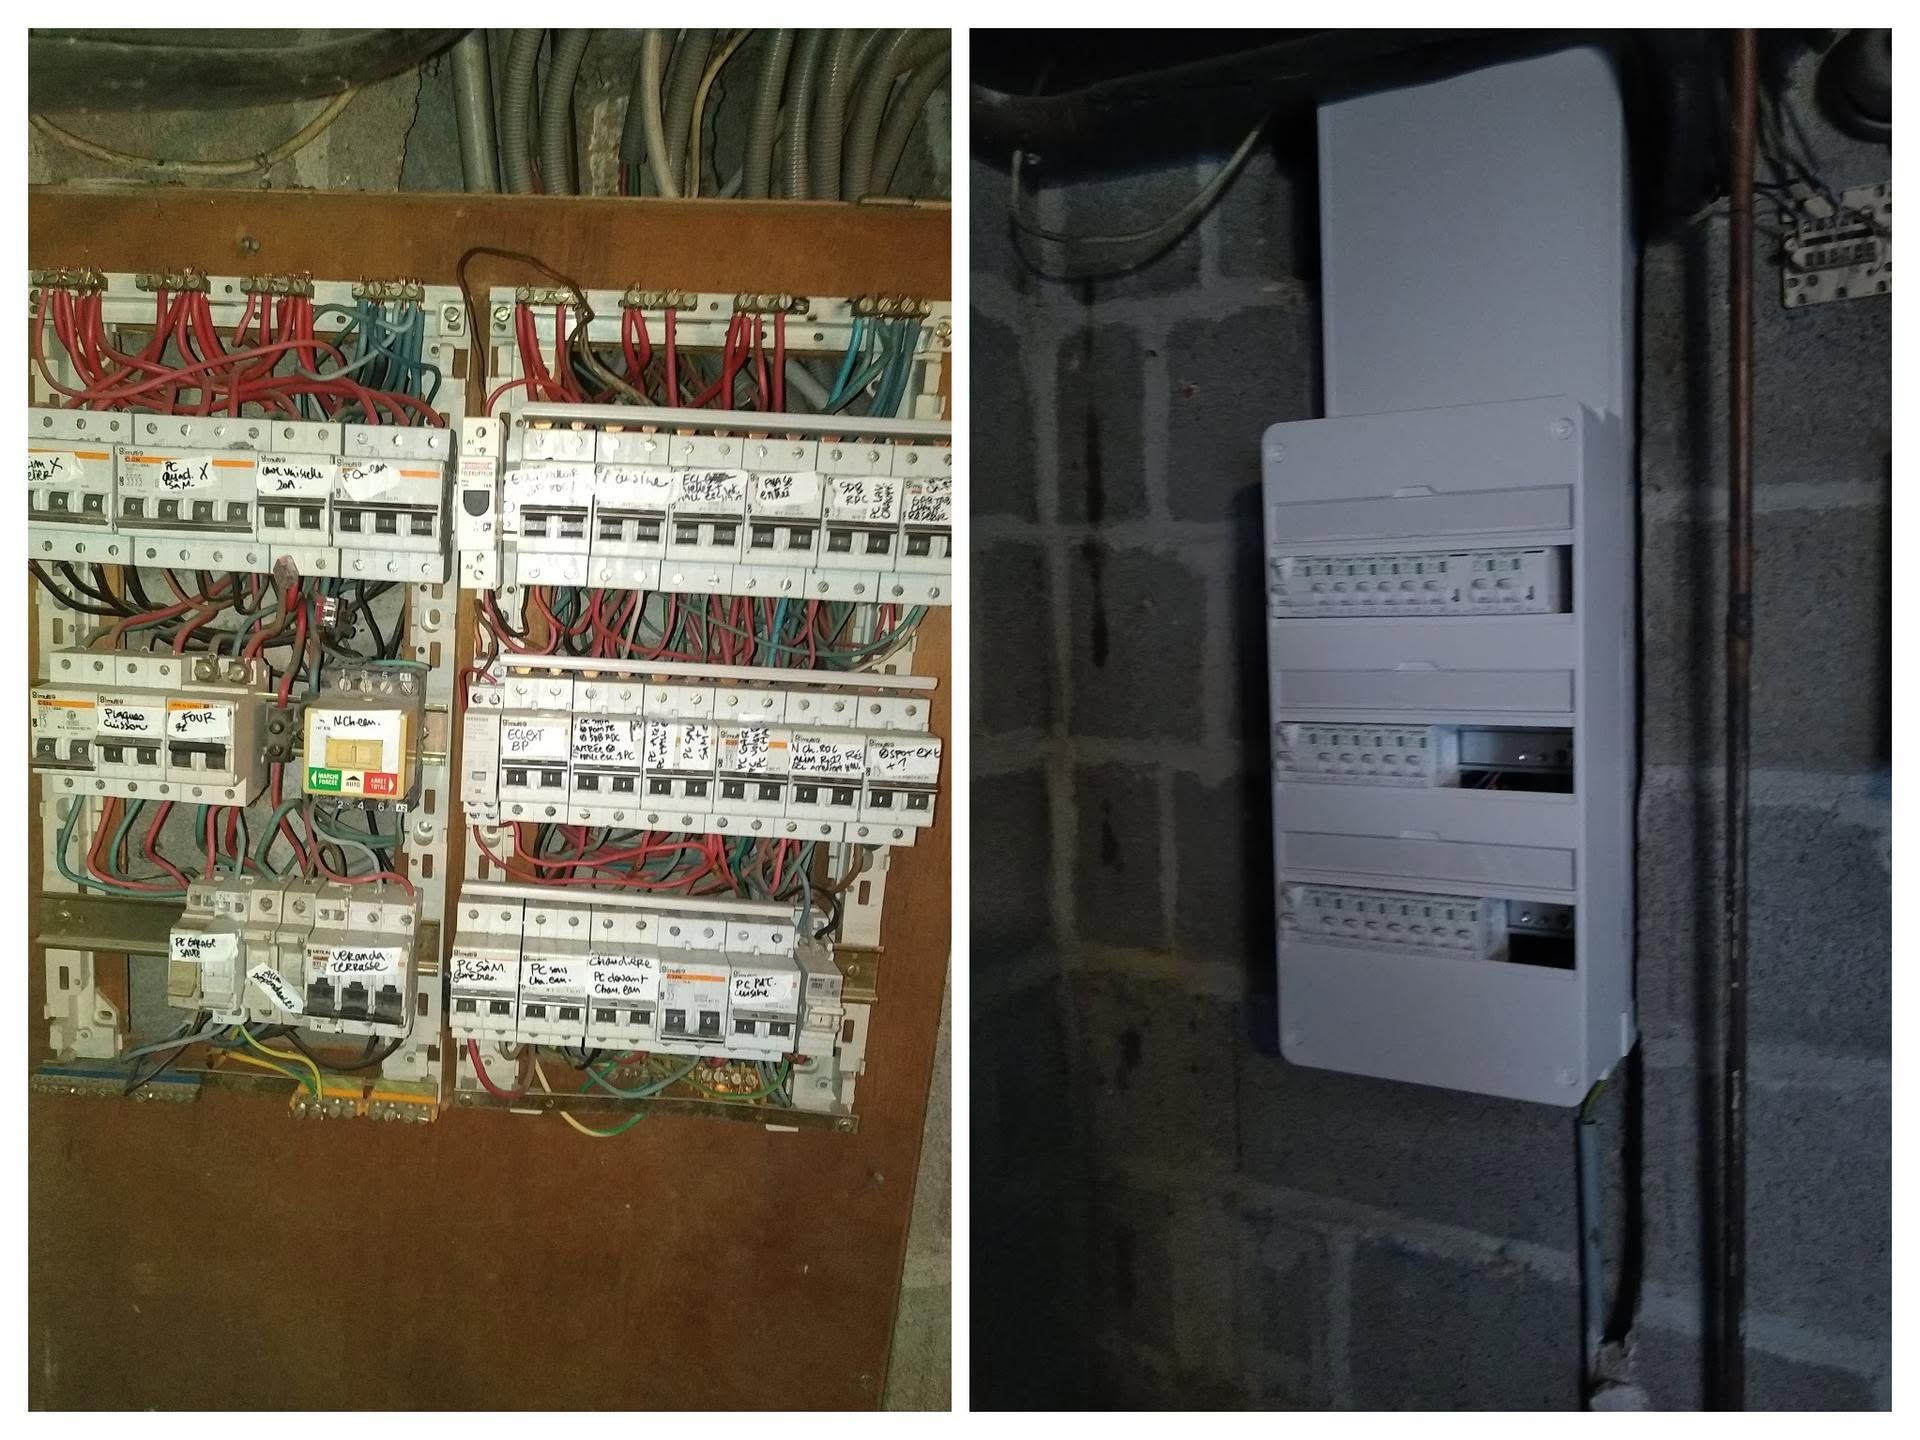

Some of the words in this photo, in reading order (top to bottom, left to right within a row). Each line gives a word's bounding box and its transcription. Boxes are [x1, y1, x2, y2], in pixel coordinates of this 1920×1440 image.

[165, 461, 178, 472] PC
[182, 711, 215, 724] FOUR
[512, 740, 529, 752] BP
[338, 800, 344, 809] 2
[358, 801, 364, 810] 4
[378, 802, 385, 811] 6
[457, 960, 472, 972] PC
[531, 963, 547, 976] PC
[594, 971, 604, 982] PC
[736, 980, 750, 989] PC
